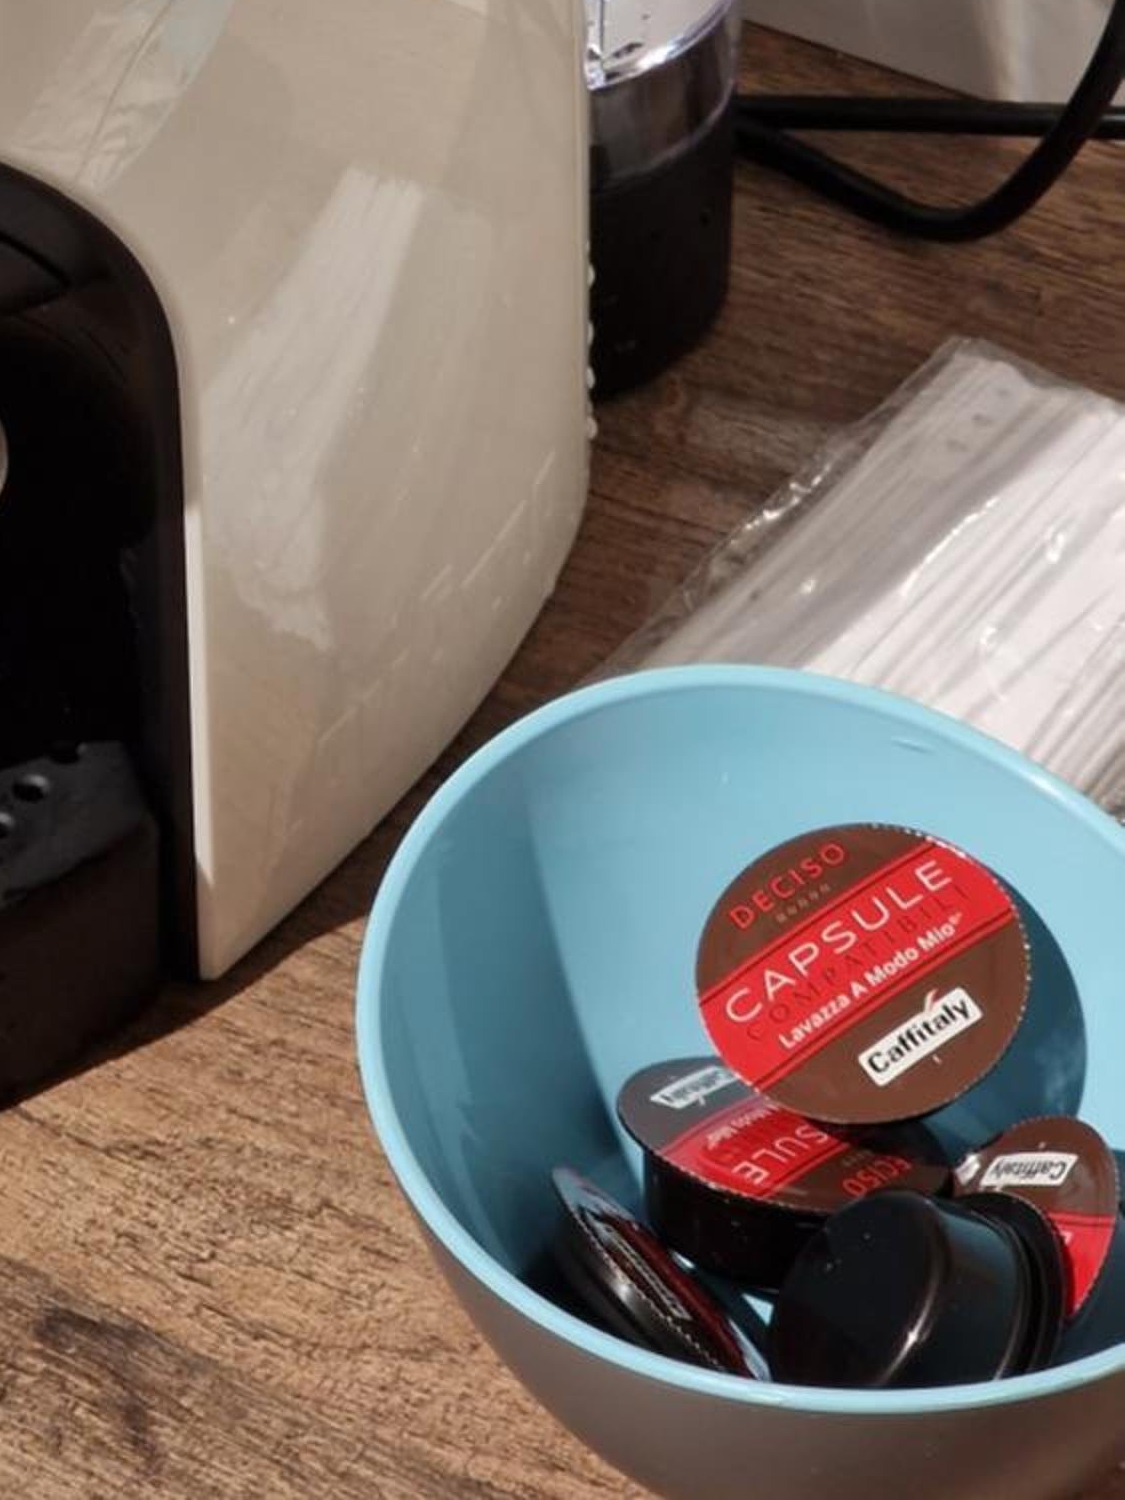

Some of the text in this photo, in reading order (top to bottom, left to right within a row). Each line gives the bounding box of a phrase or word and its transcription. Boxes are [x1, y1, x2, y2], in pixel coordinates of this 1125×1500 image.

[729, 842, 846, 930] DECISO
[724, 859, 953, 1024] CAPSULE
[778, 994, 851, 1050] Lavazza
[850, 980, 868, 999] A
[863, 948, 919, 987] Modo
[867, 997, 972, 1074] Caffitaly
[731, 1123, 829, 1185] SULE
[841, 1157, 913, 1198] ECISO
